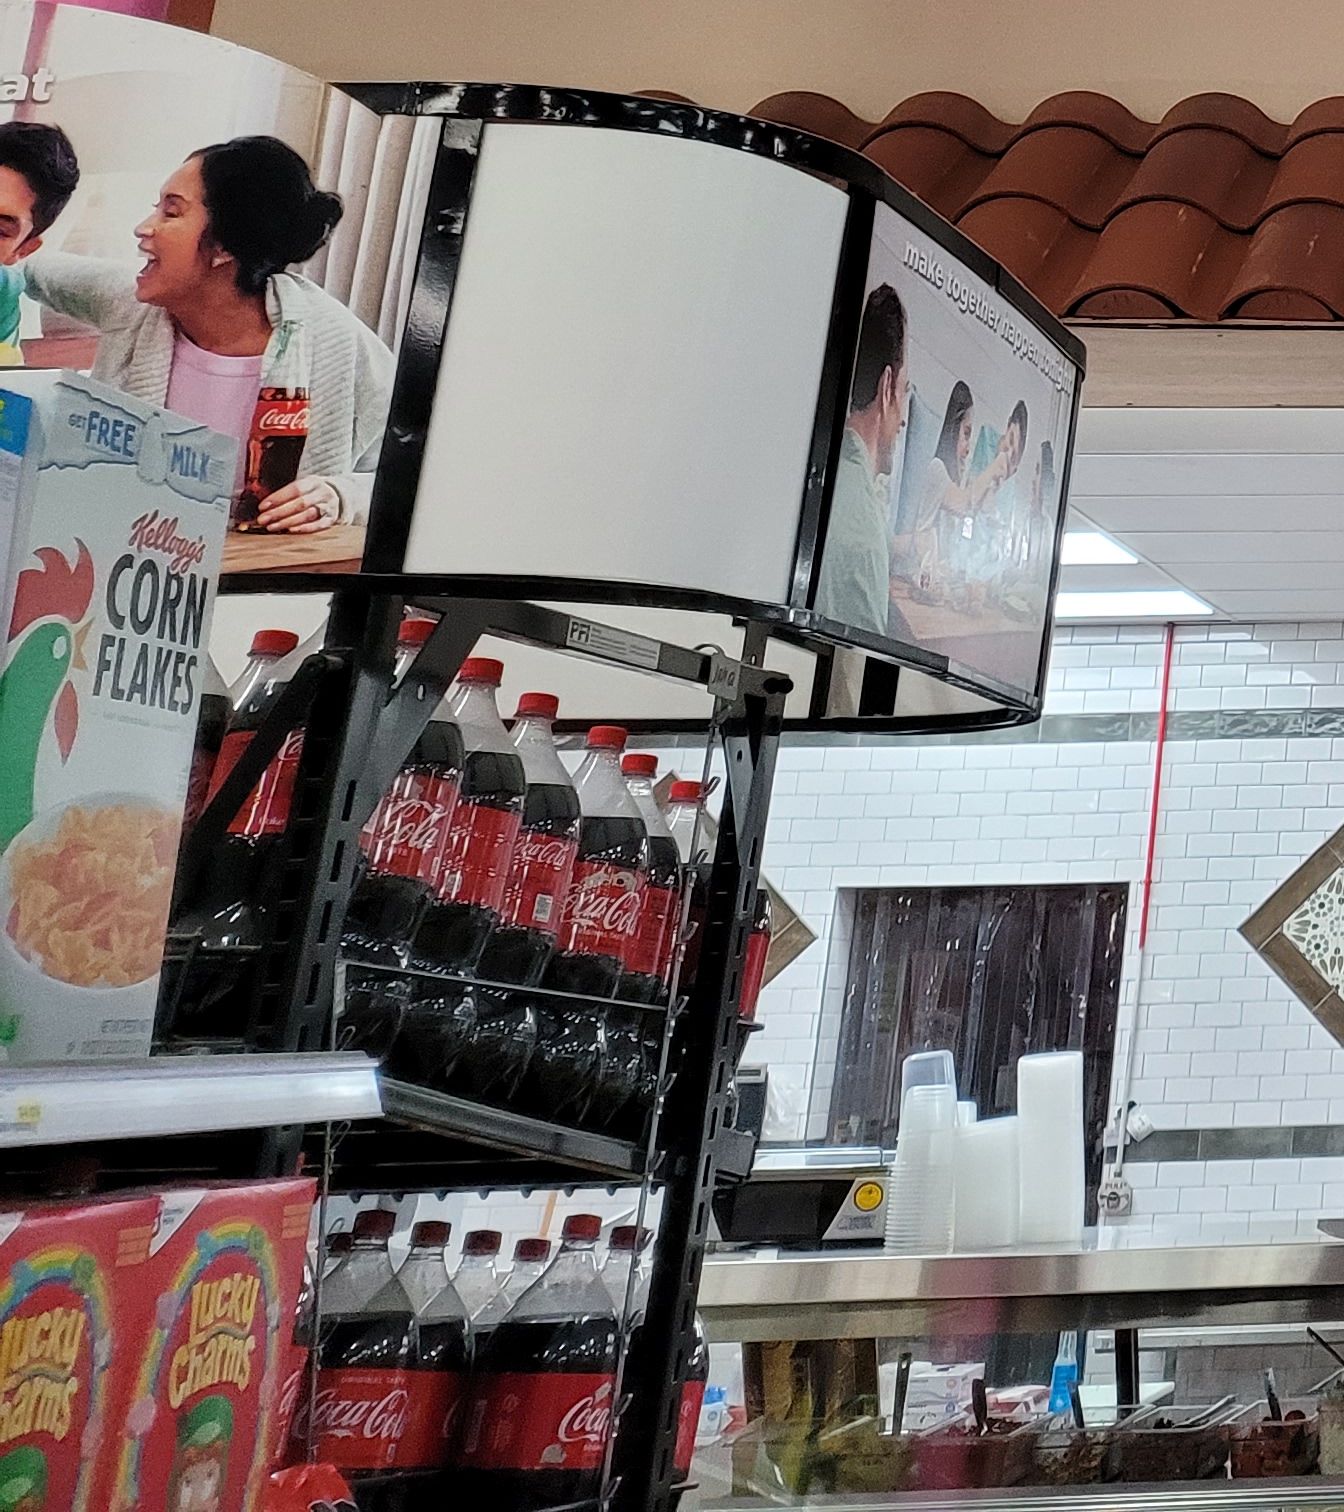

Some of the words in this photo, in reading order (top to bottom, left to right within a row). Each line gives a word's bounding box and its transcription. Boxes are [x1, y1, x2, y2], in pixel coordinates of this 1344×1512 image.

[903, 241, 944, 289] make
[945, 271, 1001, 334] together
[1000, 312, 1039, 365] happen
[68, 413, 87, 430] GET
[86, 410, 137, 458] FREE
[170, 442, 210, 483] MILK
[128, 509, 206, 573] Kellogg's
[106, 553, 208, 650] CORN
[92, 632, 200, 717] FLAKES
[169, 1334, 256, 1410] Charms
